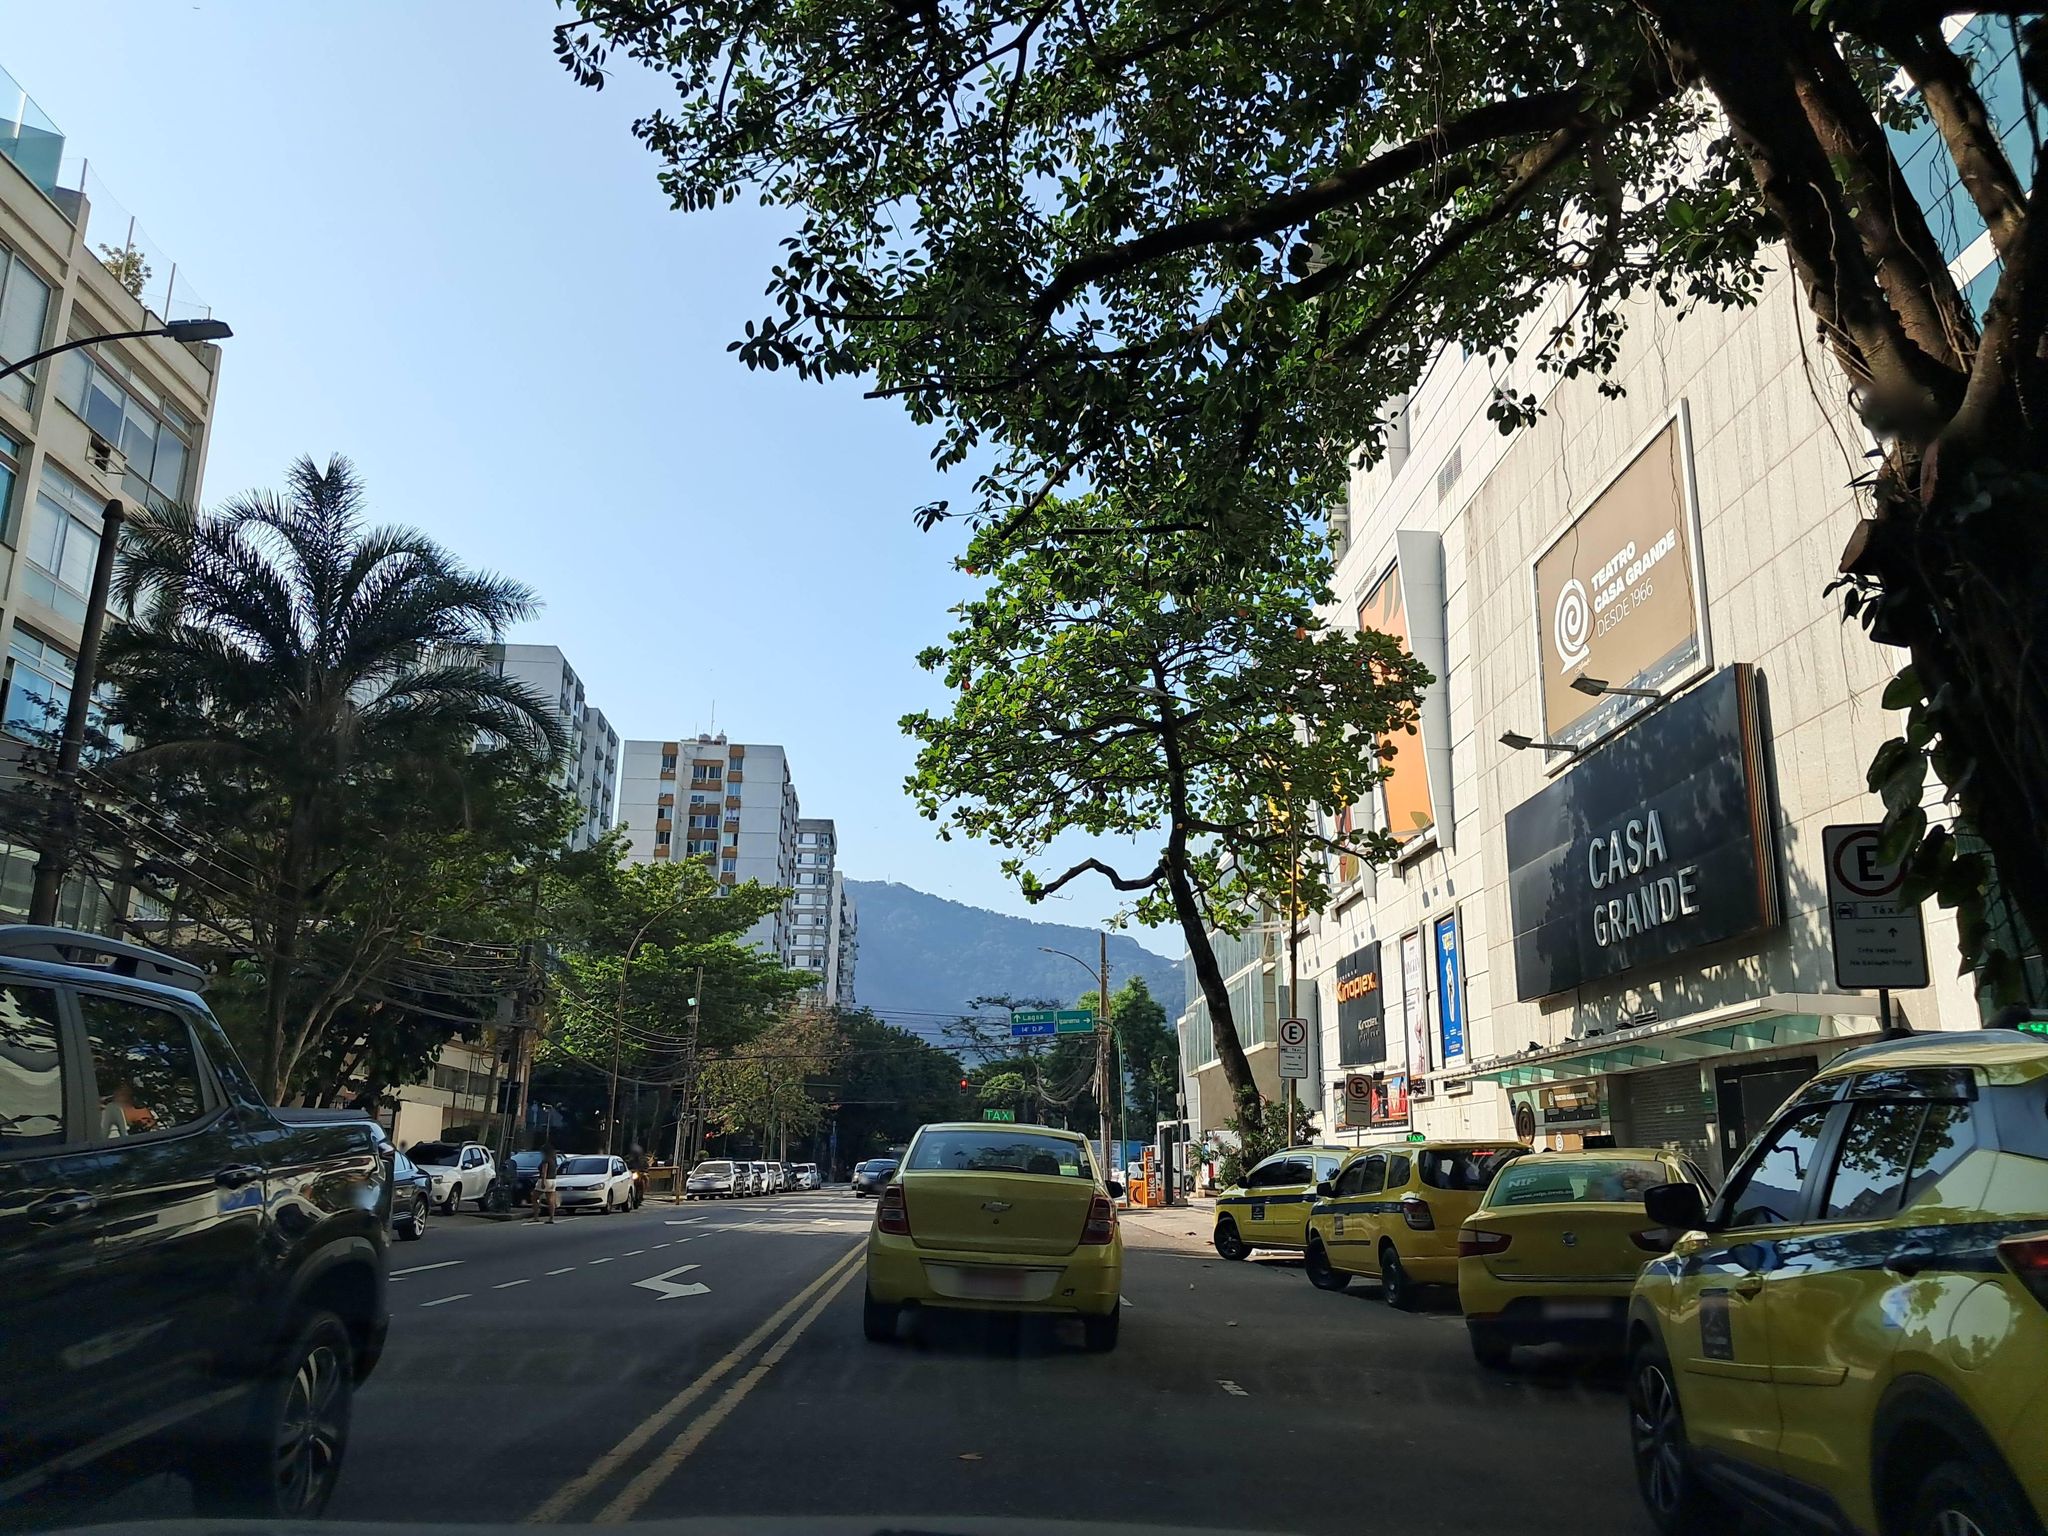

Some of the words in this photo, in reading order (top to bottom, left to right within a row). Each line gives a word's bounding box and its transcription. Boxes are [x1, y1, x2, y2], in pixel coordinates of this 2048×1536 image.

[1591, 540, 1636, 591] TEATRO
[1594, 576, 1626, 613] CASA
[1625, 528, 1676, 586] GRANDE
[1597, 597, 1631, 637] DESDE
[1630, 578, 1654, 608] 1966
[1588, 809, 1668, 889] CASA
[1856, 845, 1885, 882] E
[1593, 864, 1700, 947] GRANDE
[1871, 904, 1899, 915] Táx
[1022, 1014, 1044, 1022] Lagoa
[1288, 1025, 1298, 1040] E
[1407, 1134, 1424, 1142] TAXI
[1148, 1177, 1156, 1199] bike
[1508, 1177, 1538, 1189] NIP
